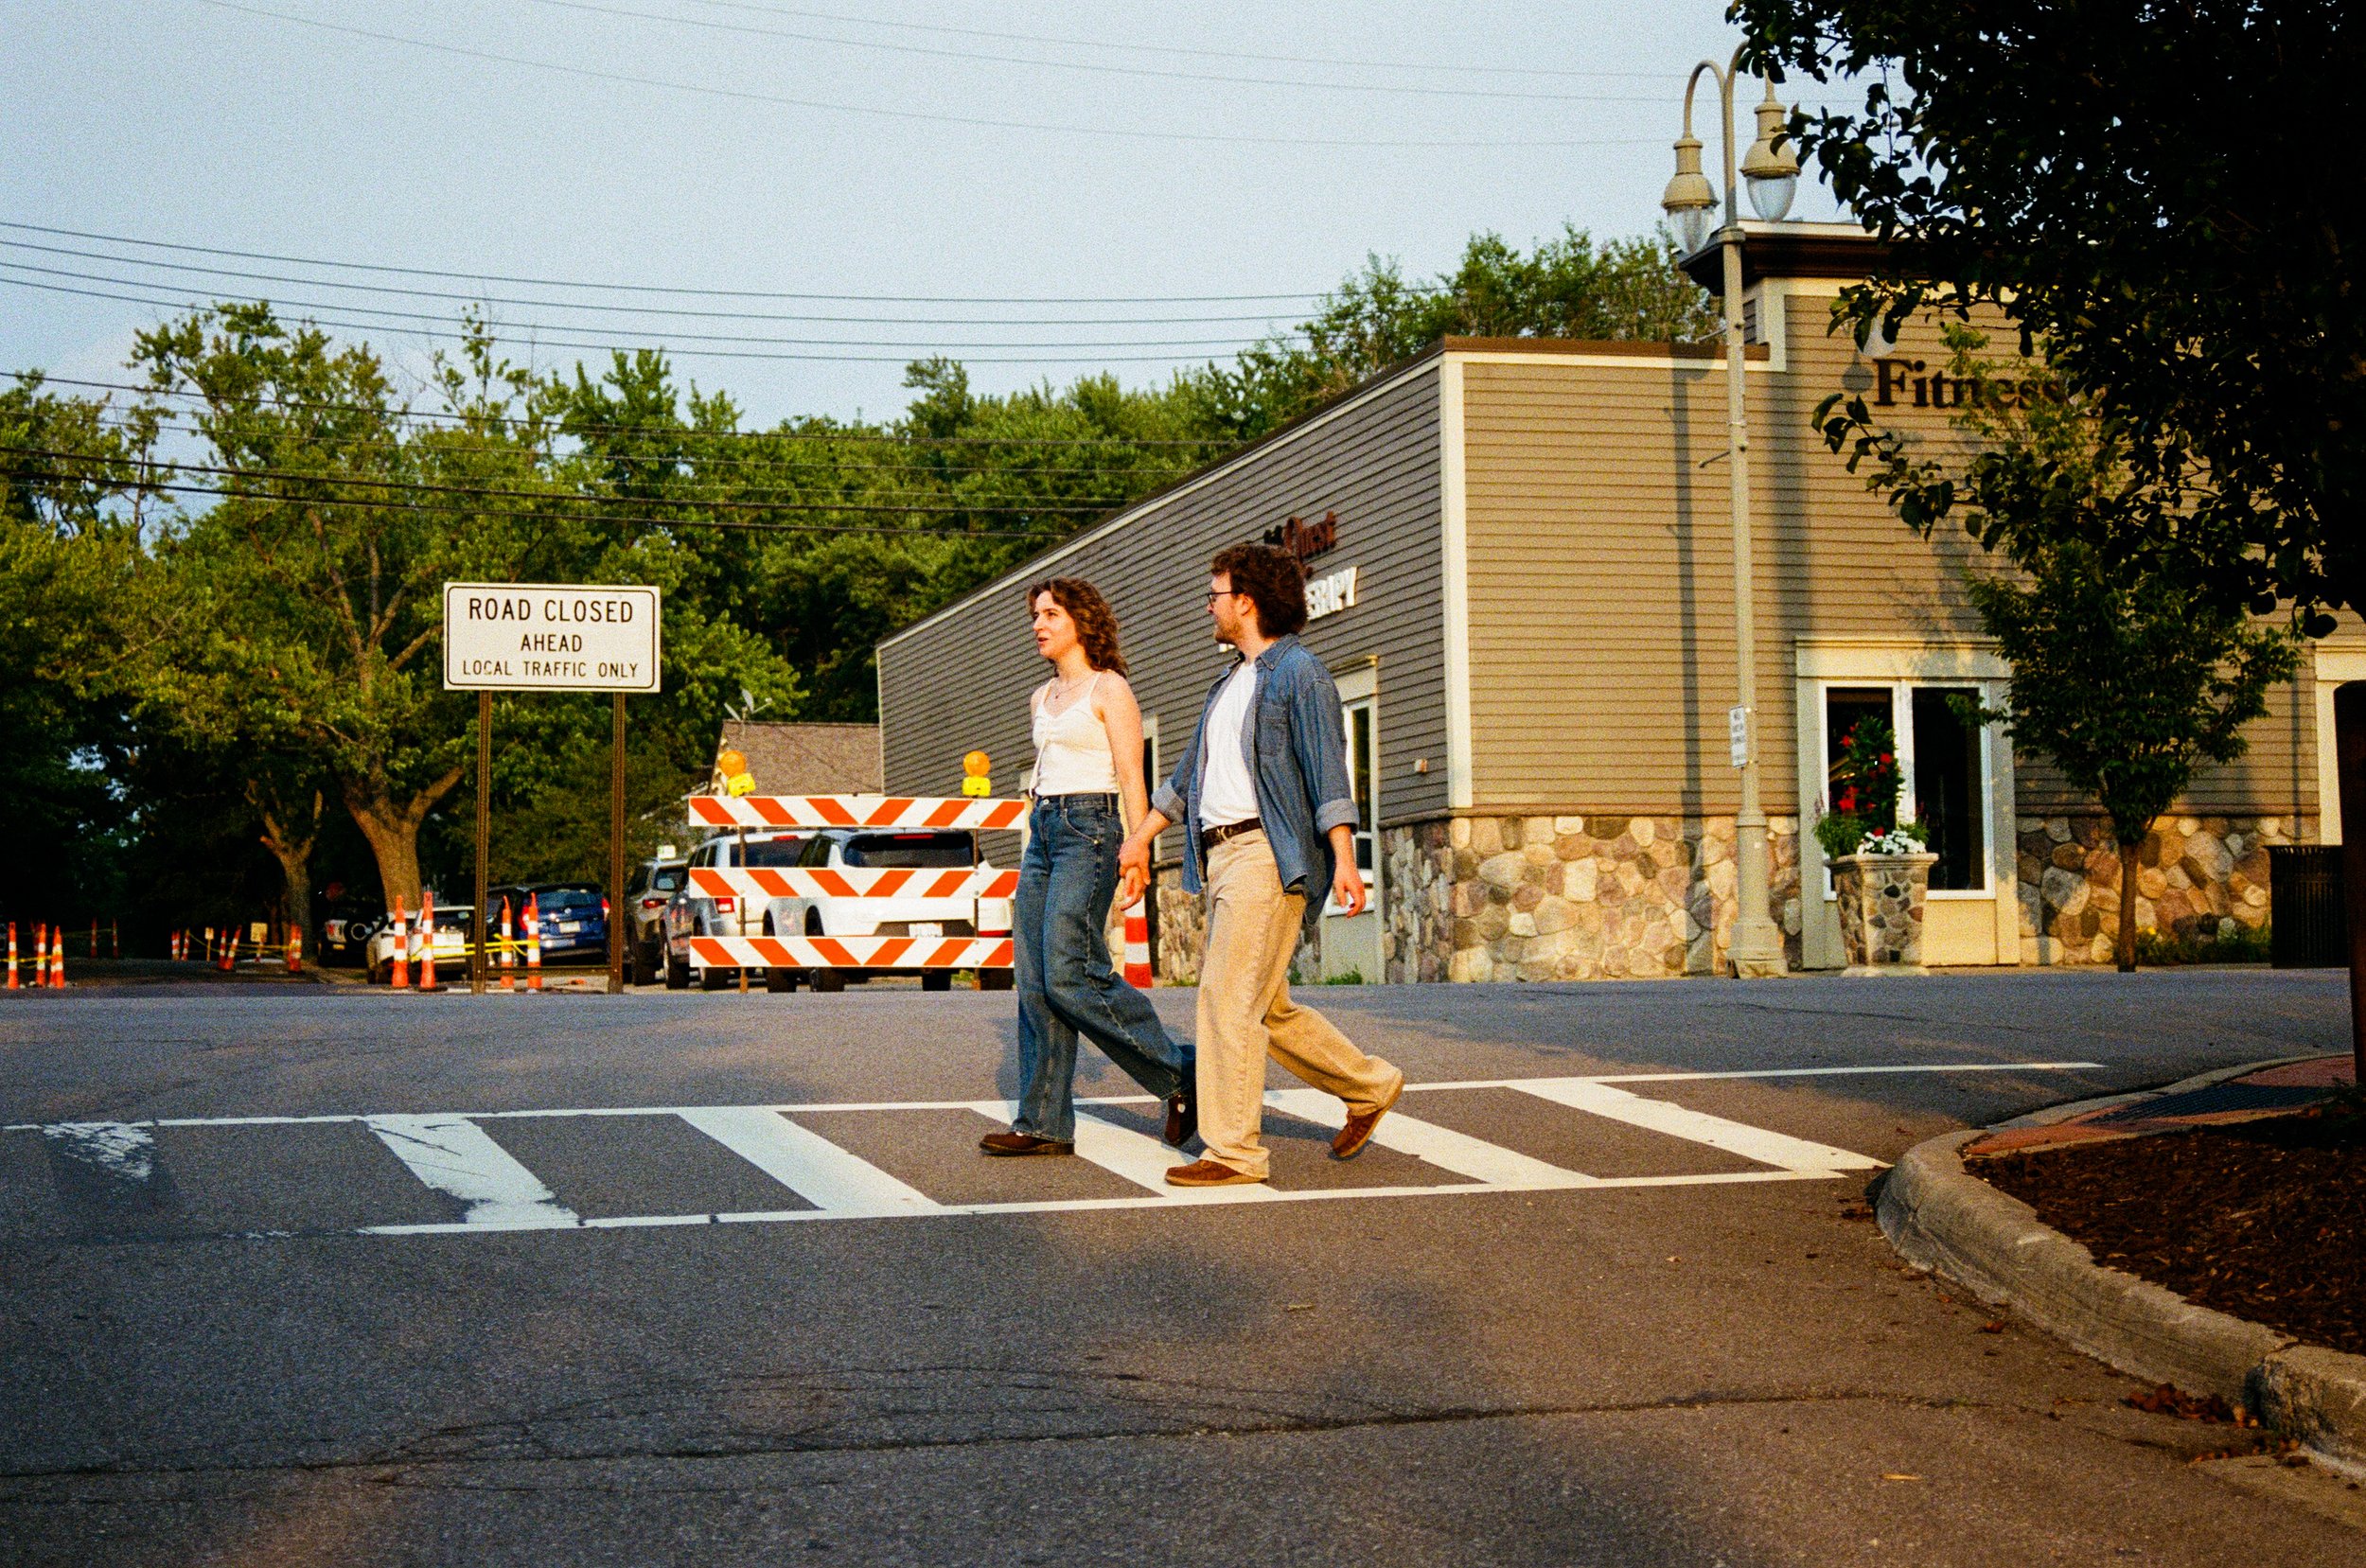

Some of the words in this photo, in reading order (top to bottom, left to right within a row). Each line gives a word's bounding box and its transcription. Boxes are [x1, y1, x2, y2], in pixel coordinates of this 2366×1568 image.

[469, 598, 531, 621] ROAD
[544, 600, 633, 623] CLOSED
[521, 634, 582, 652] AHEAD
[463, 661, 512, 676] LOCAL
[524, 661, 587, 678] TRAFFIC
[598, 662, 638, 678] ONLY
